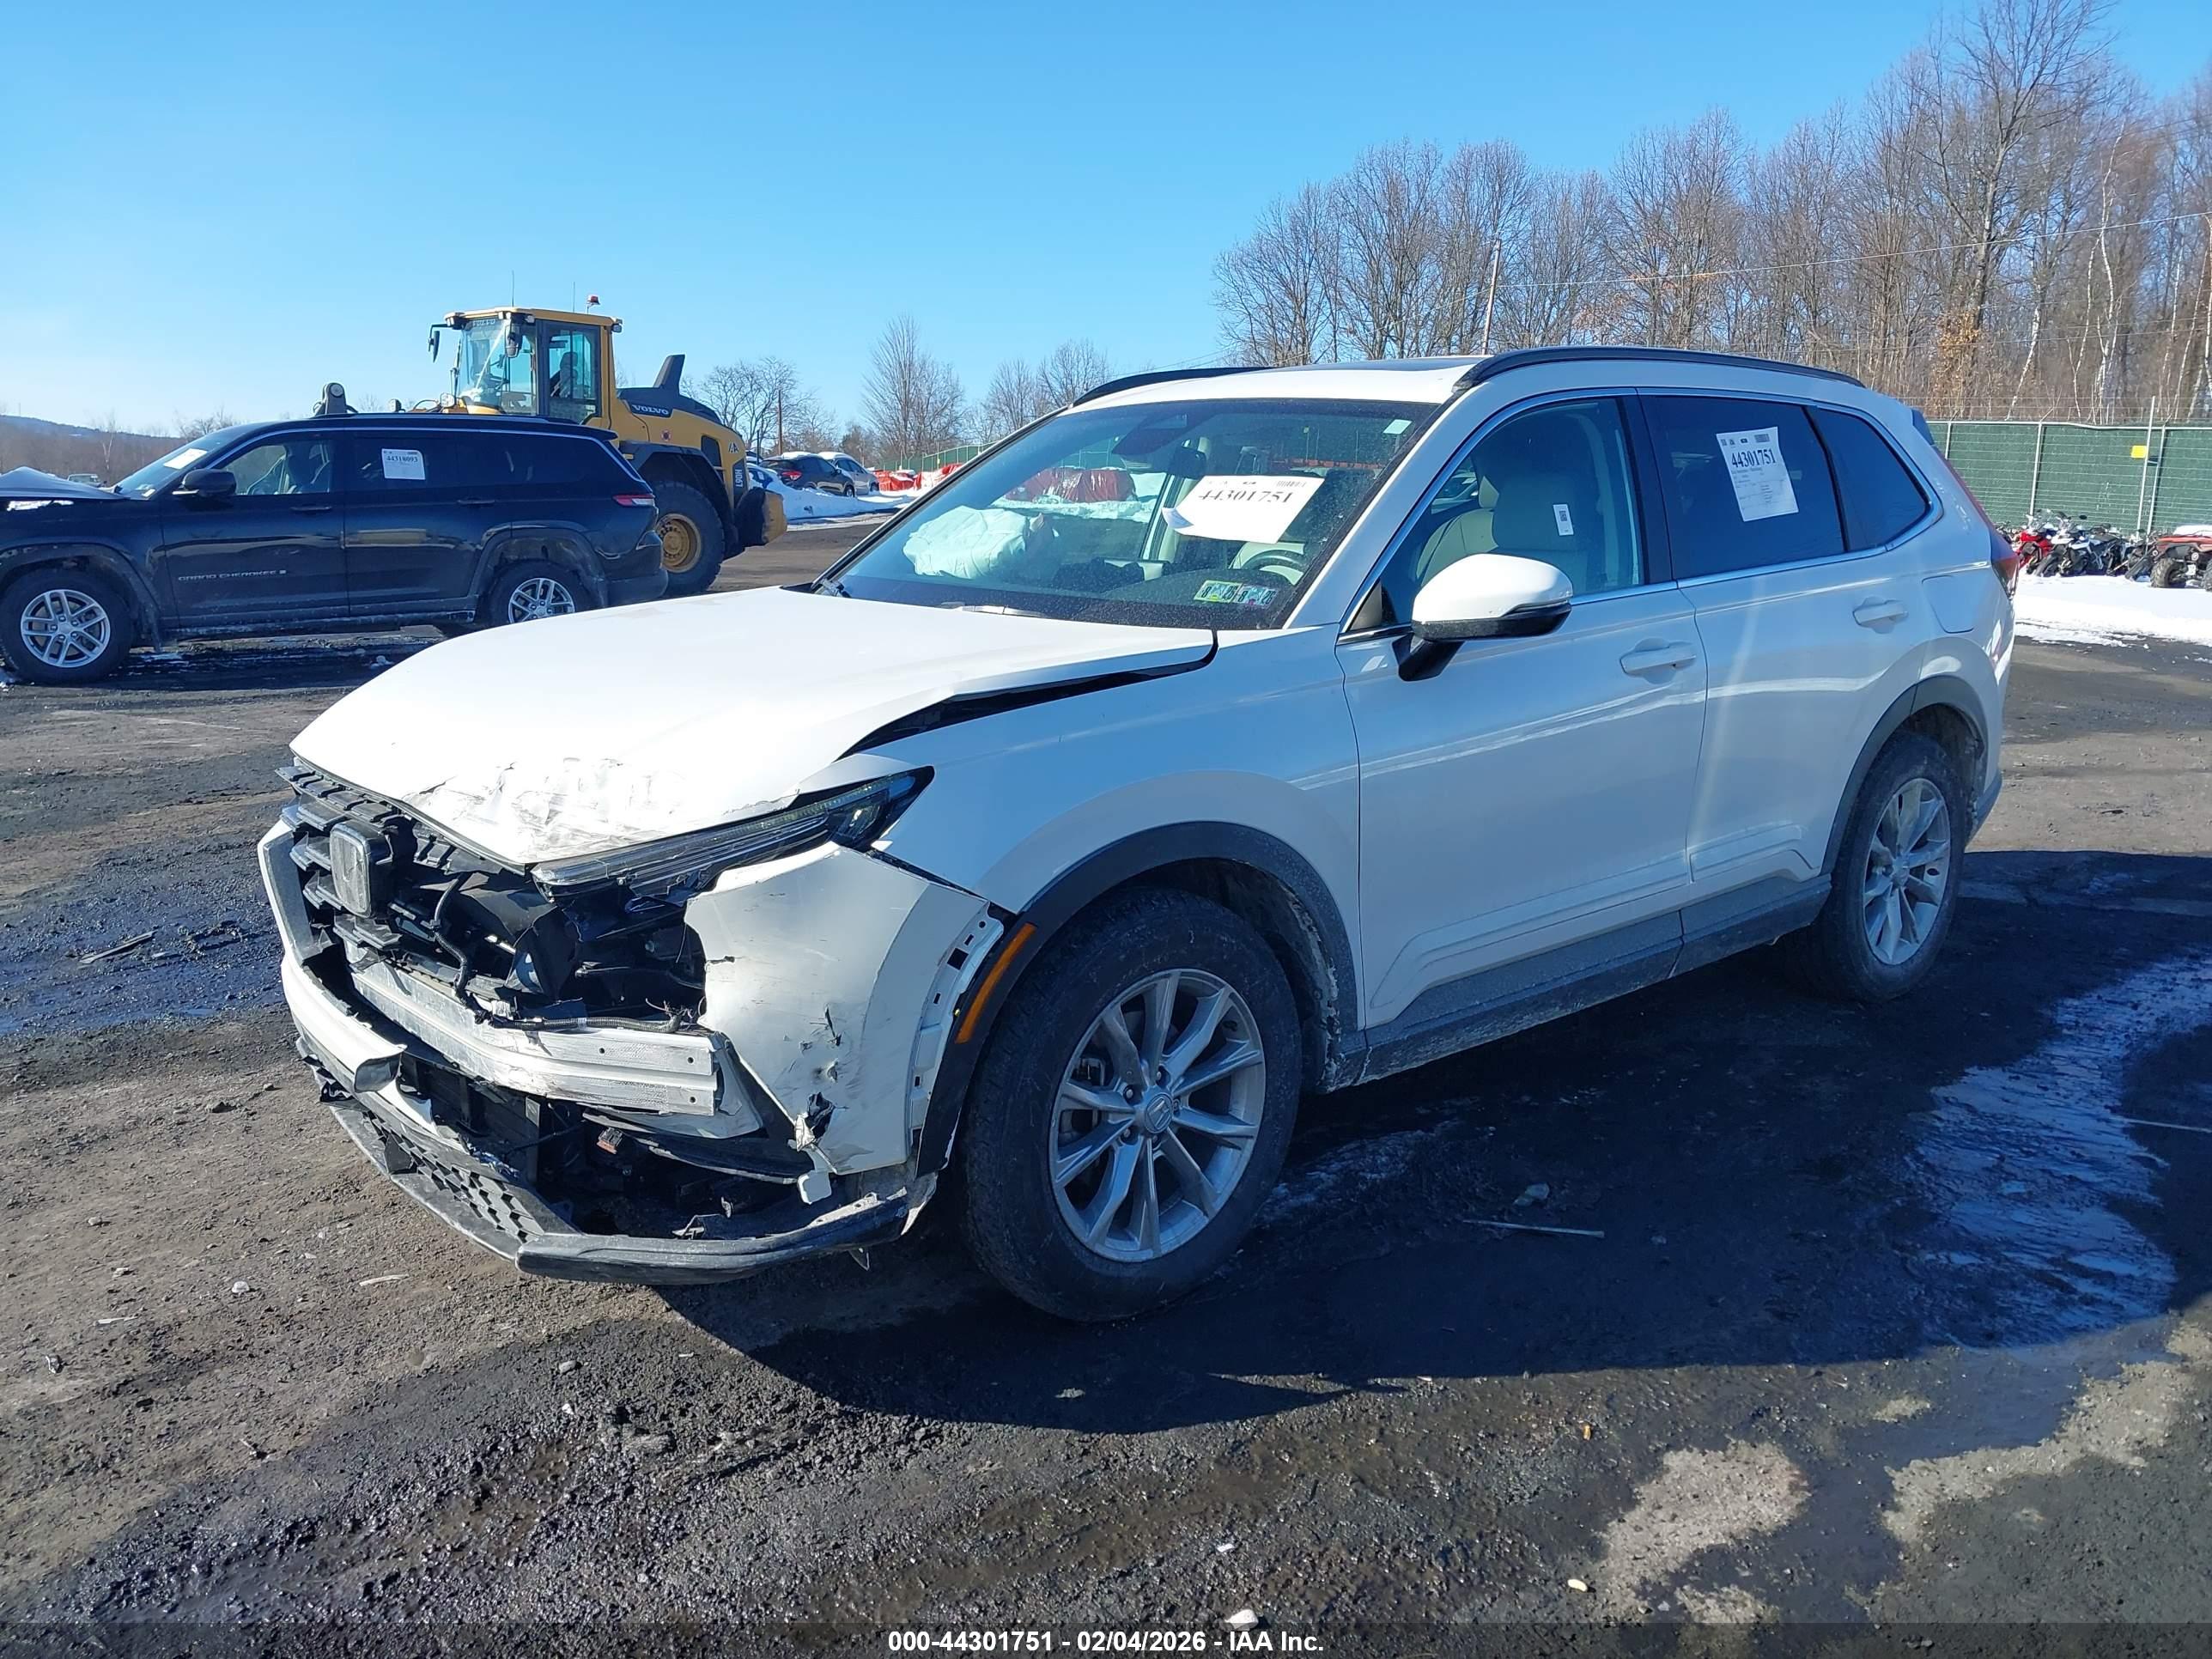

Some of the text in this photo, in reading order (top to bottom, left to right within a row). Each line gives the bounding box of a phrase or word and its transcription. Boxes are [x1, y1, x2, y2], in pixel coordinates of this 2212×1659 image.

[631, 404, 670, 416] VOLVO
[1731, 448, 1776, 468] 44301751
[734, 469, 744, 488] L90H
[1199, 489, 1294, 503] 44301751
[219, 570, 276, 579] CHEROKEE
